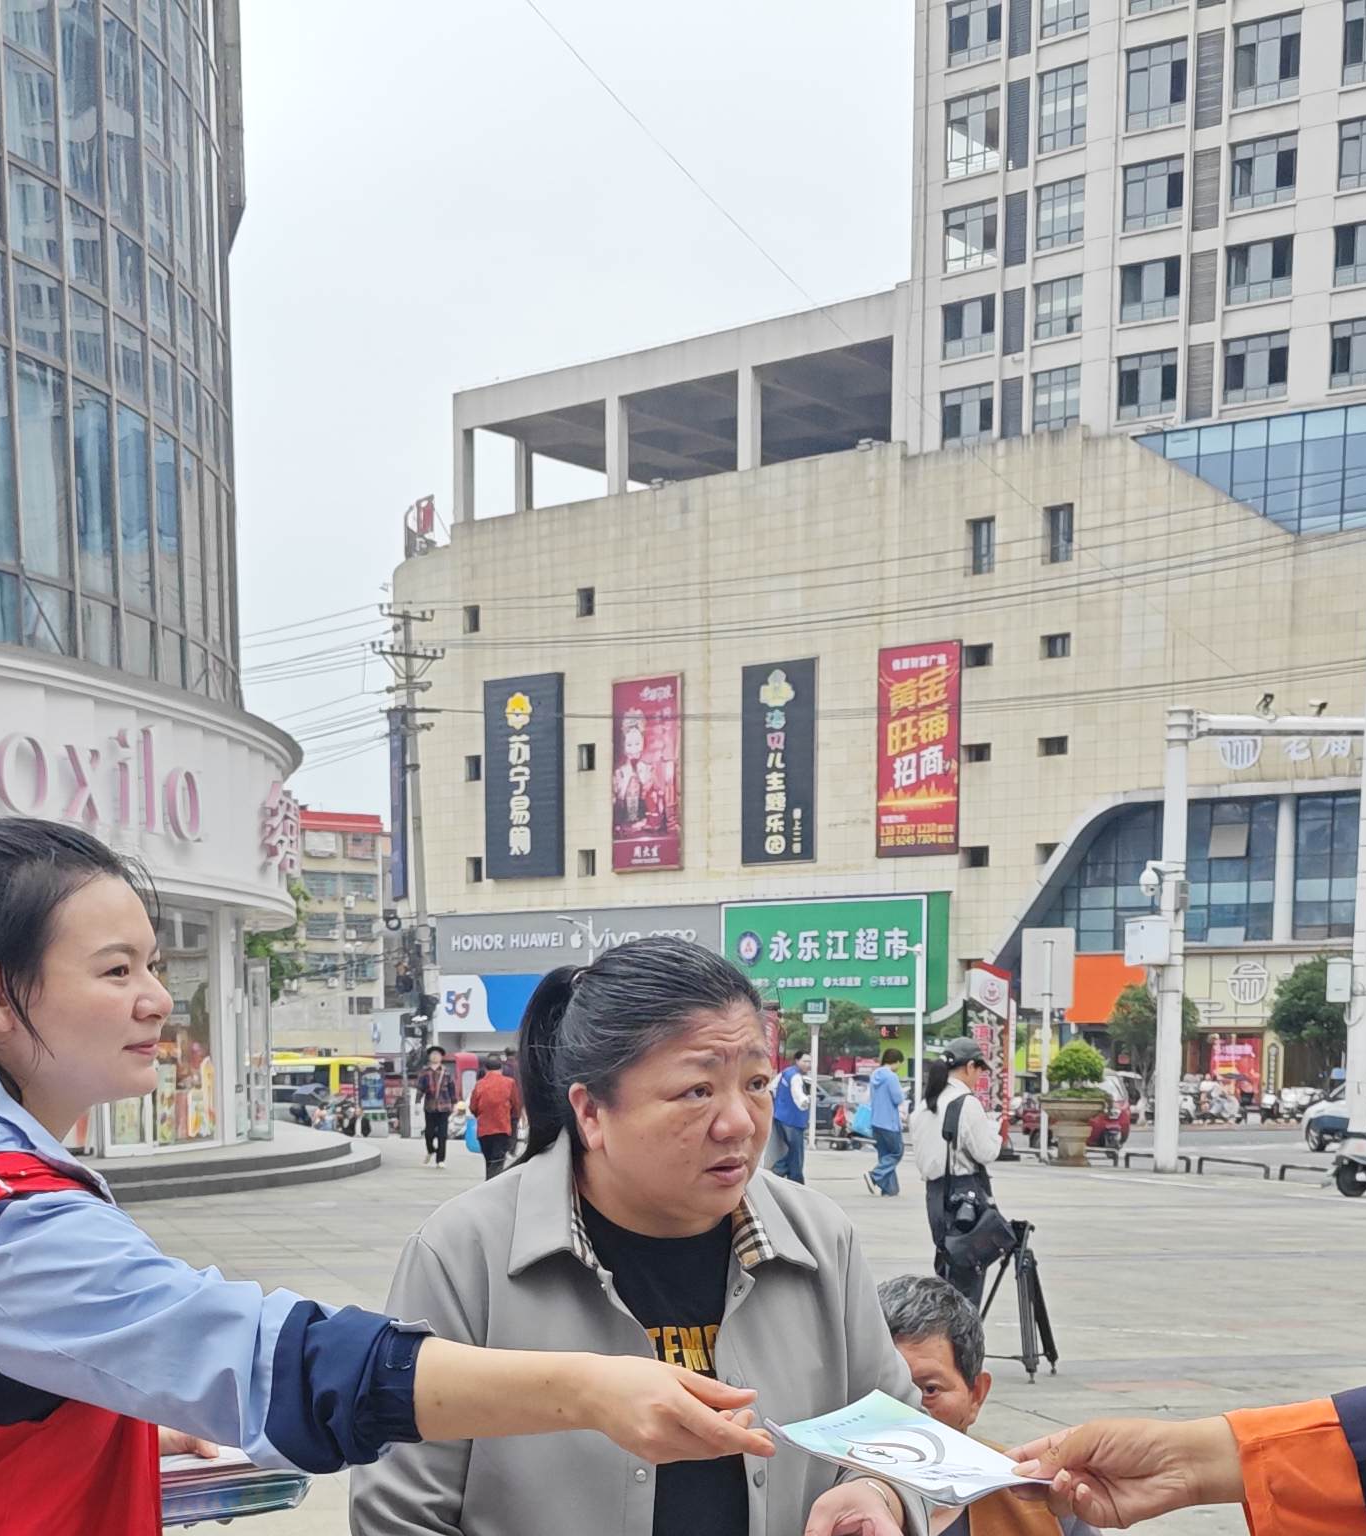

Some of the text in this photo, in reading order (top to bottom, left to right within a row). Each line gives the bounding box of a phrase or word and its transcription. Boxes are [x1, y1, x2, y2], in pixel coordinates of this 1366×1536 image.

[890, 665, 951, 716] 黄金
[887, 704, 952, 756] 旺铺
[893, 744, 944, 789] 招商
[508, 733, 532, 856] 苏宁易购
[450, 934, 504, 951] HONOR
[509, 931, 564, 949] HUAWEI
[769, 927, 910, 962] 永乐江超市
